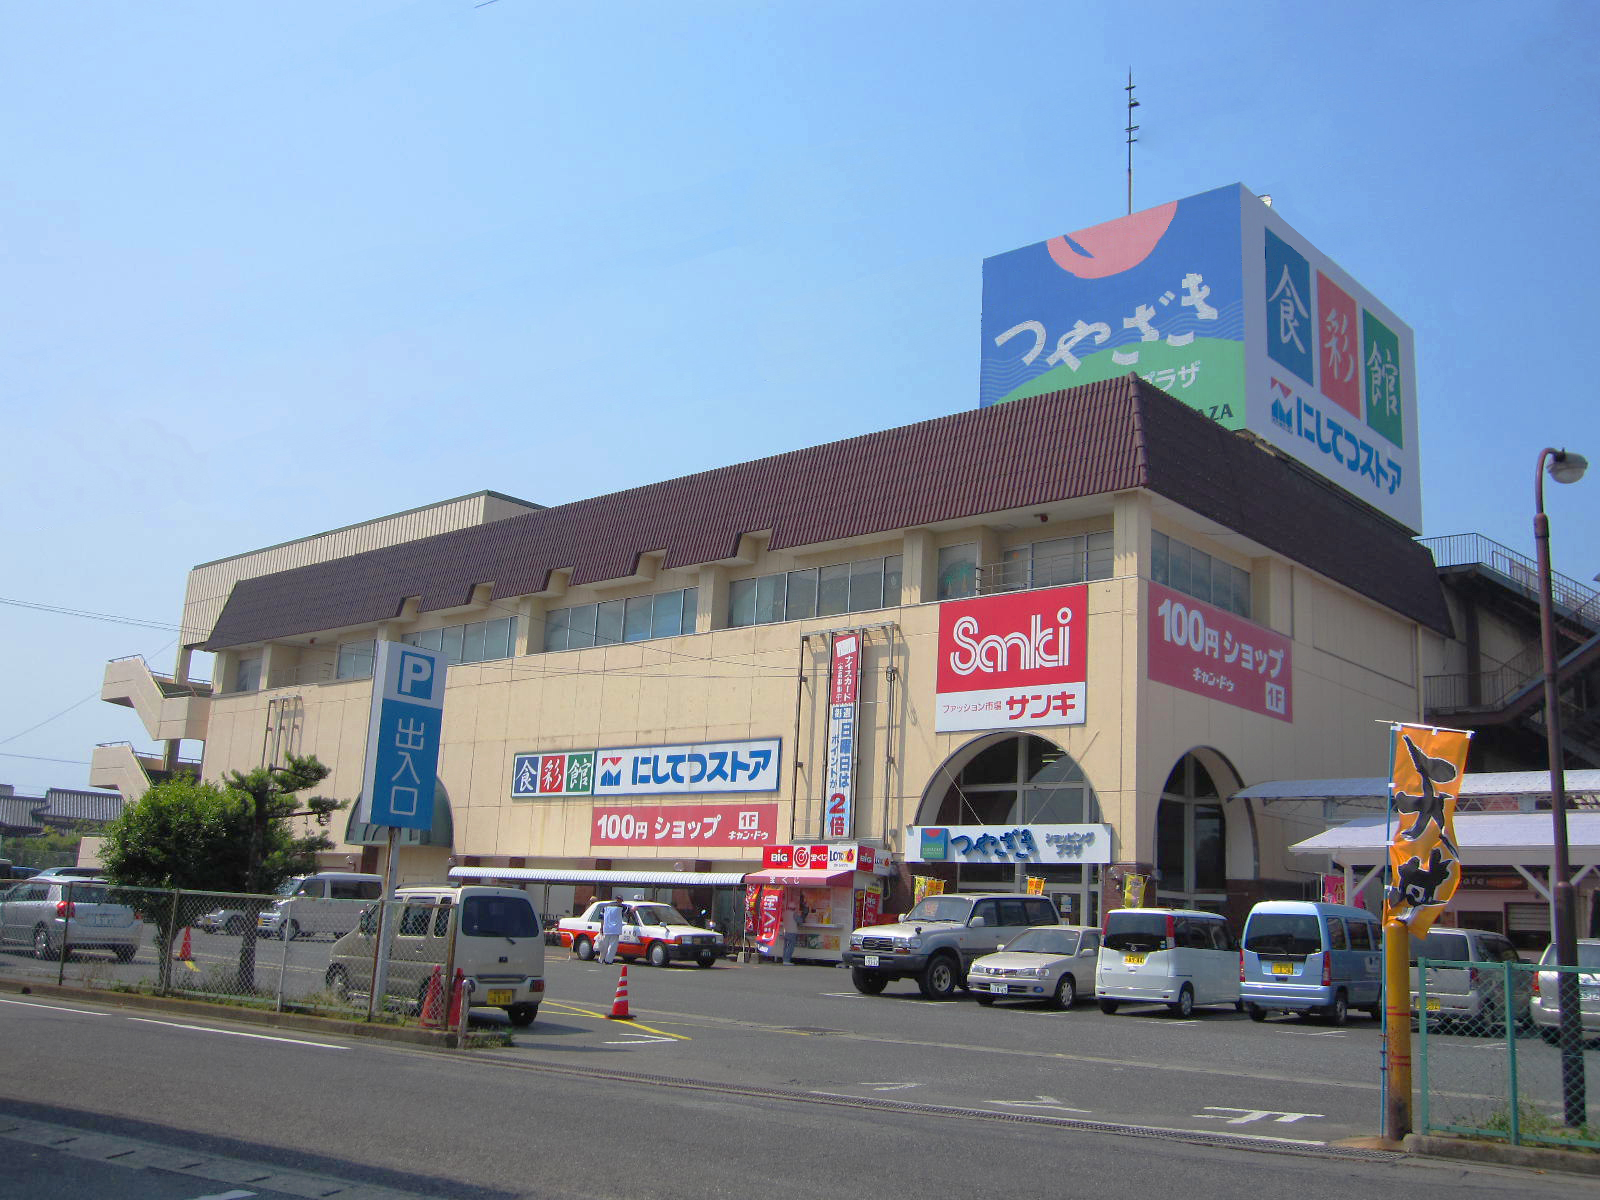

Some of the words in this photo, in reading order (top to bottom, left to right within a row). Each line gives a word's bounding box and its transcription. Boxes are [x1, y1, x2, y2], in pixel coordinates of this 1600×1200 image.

[994, 273, 1218, 372] つやざき
[1268, 263, 1398, 417] 食彩館
[1296, 396, 1402, 495] にしてつストア
[950, 606, 1073, 676] Sanki
[1158, 599, 1219, 660] 100円
[1224, 630, 1284, 679] ショップ
[401, 654, 432, 694] P
[844, 655, 854, 702] ナイスカード
[1006, 690, 1076, 721] サンキ
[390, 717, 425, 817] 出入口
[516, 758, 591, 792] 食彩館
[631, 749, 772, 785] にしてつストア
[597, 814, 648, 840] 100円
[654, 814, 721, 840] ショップ
[740, 813, 758, 828] 1F
[951, 827, 1036, 859] つやざき
